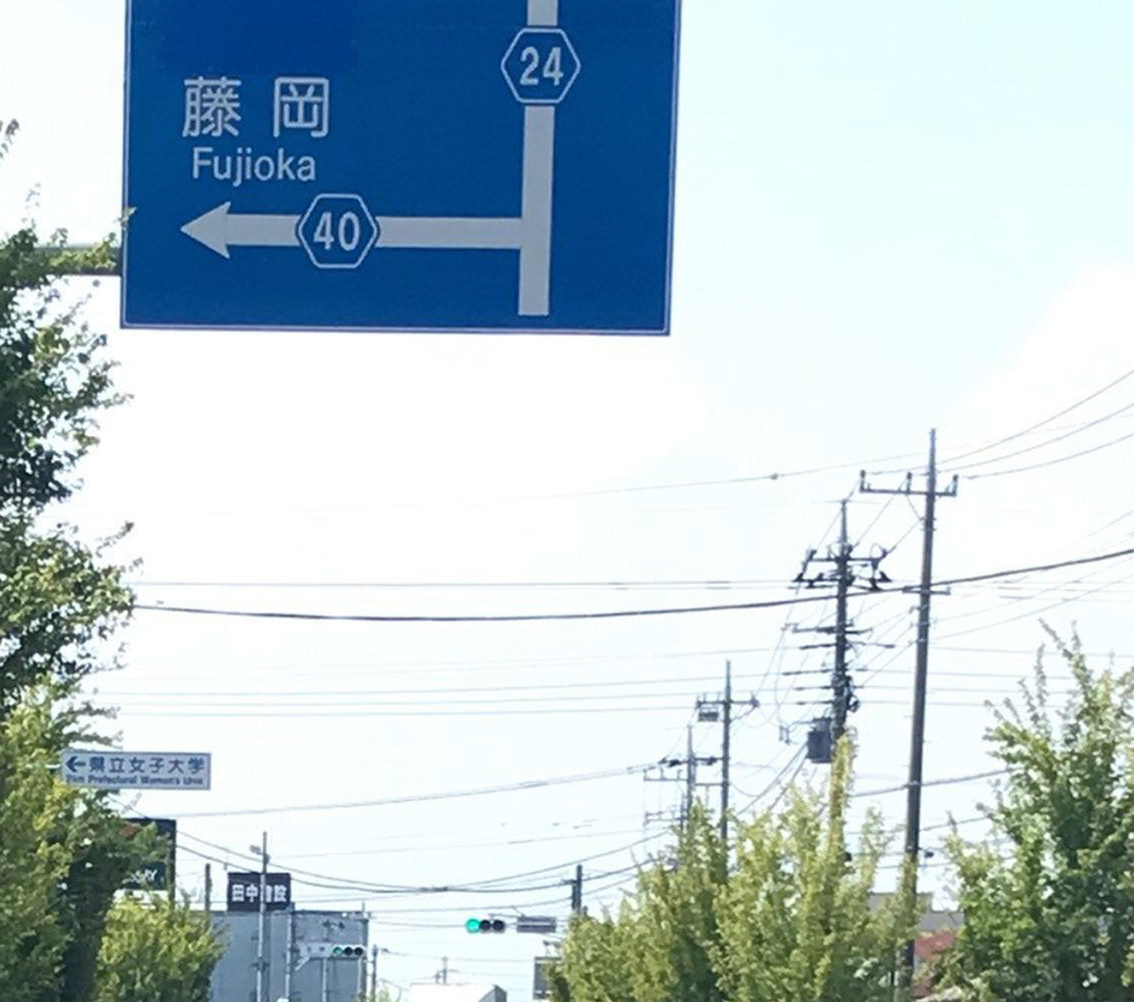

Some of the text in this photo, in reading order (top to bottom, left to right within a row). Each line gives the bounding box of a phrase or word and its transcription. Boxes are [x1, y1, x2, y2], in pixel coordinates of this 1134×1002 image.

[519, 46, 565, 87] 24
[182, 76, 329, 138] 藤岡
[192, 147, 316, 187] Fujioka
[313, 211, 360, 251] 40
[89, 756, 204, 775] 県立女子大学
